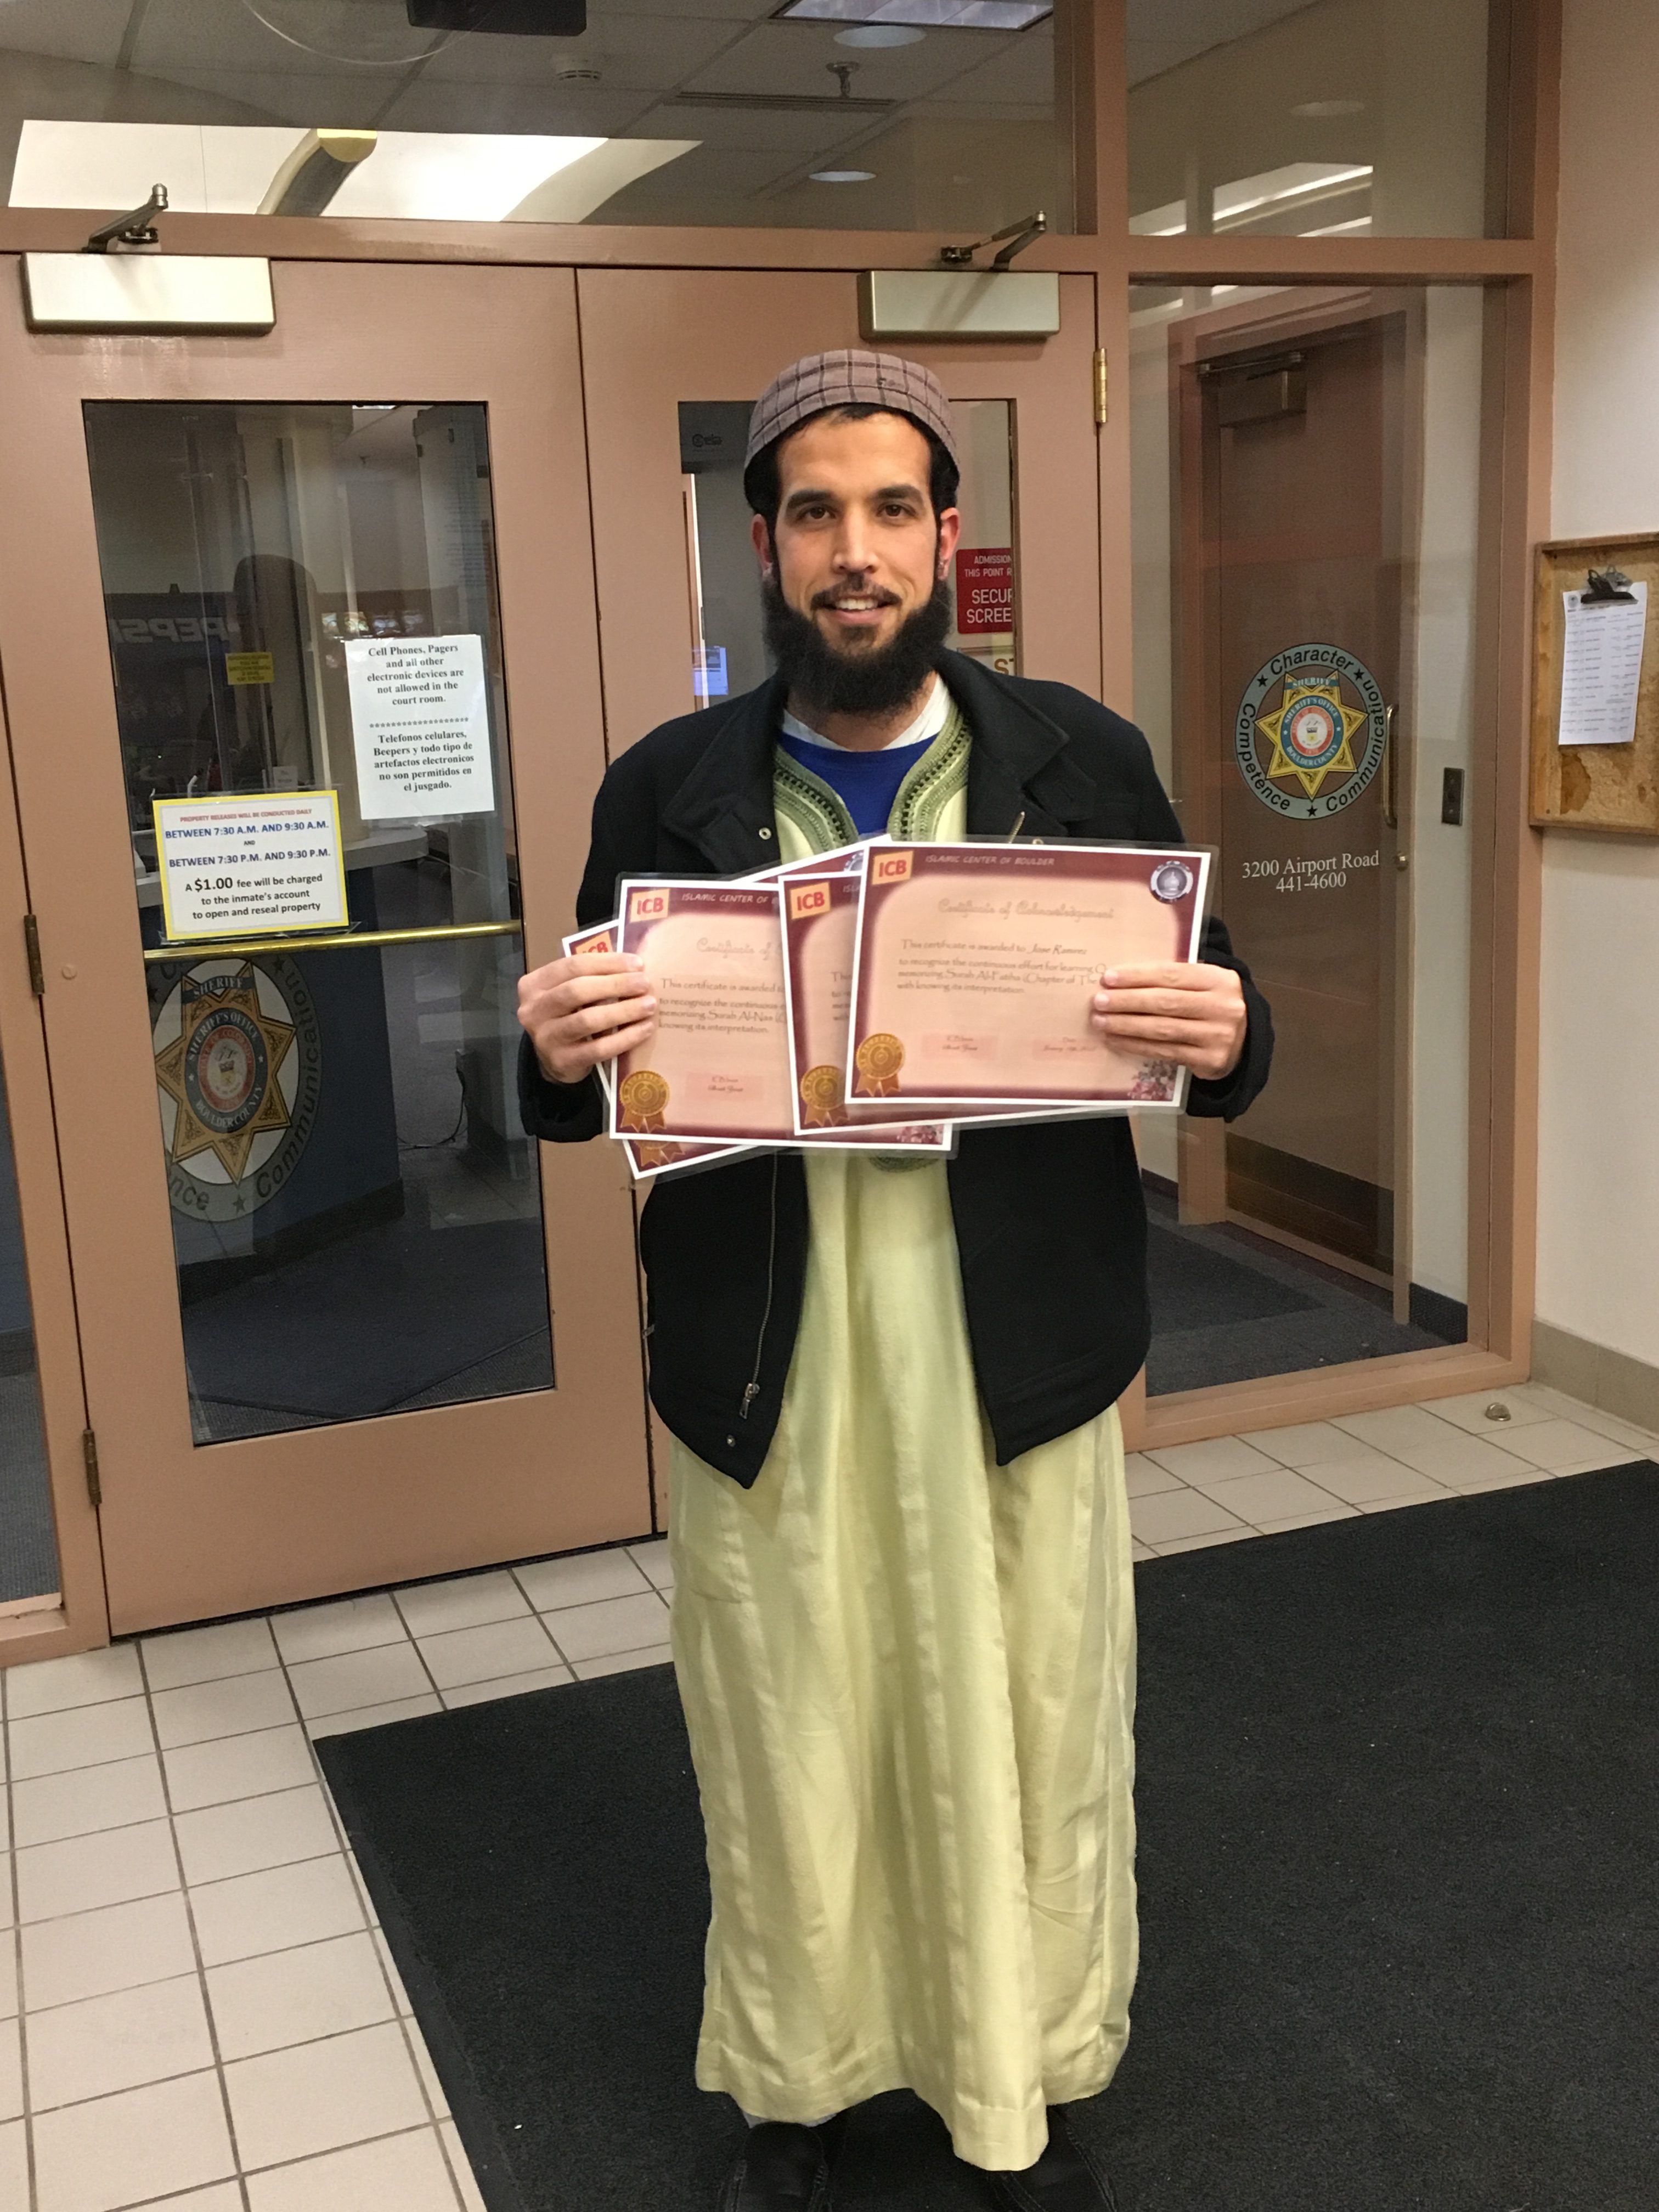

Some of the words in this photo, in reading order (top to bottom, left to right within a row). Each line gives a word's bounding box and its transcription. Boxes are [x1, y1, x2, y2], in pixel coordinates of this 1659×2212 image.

[965, 569, 980, 577] THIS
[983, 568, 1003, 577] POINT
[368, 646, 387, 657] Cell
[391, 646, 426, 656] Phones,
[428, 645, 458, 654] Pagers
[386, 659, 403, 668] and
[406, 658, 417, 667] all
[420, 658, 444, 666] other
[1271, 649, 1354, 675] Character
[368, 672, 413, 681] electronic
[415, 670, 448, 679] devices
[396, 682, 430, 693] allowed
[392, 697, 416, 705] court
[378, 733, 422, 743] Telefonos
[425, 731, 466, 741] celulares,
[374, 747, 410, 757] Beepers
[421, 744, 441, 753] todo
[443, 743, 461, 754] tipo
[1326, 680, 1384, 811] Communication
[374, 759, 420, 768] artefactos
[422, 755, 474, 765] electronicos
[1239, 703, 1290, 810] Competence
[412, 768, 460, 781] permitidos
[414, 781, 452, 792] jusgado.
[166, 829, 211, 839] BETWEEN
[214, 827, 234, 836] 7:30
[237, 826, 258, 834] A.M.
[262, 824, 282, 832] AND
[285, 822, 304, 831] 9:30
[307, 821, 329, 829] A.M.
[169, 857, 215, 868] BETWEEN
[218, 855, 238, 864] 7:30
[241, 854, 262, 862] P.M.
[264, 852, 285, 860] AND
[287, 850, 307, 859] 9:30
[926, 855, 960, 863] ISLAMIC
[963, 855, 996, 864] CENTER
[1015, 857, 1054, 865] BOULDER
[1242, 860, 1279, 878] 3200
[1283, 856, 1337, 876] Airport
[1342, 850, 1379, 869] Road
[878, 860, 907, 878] ICB
[194, 877, 233, 892] $1.00
[237, 879, 251, 888] fee
[254, 878, 270, 887] will
[273, 877, 284, 885] be
[286, 874, 323, 885] charged
[1276, 872, 1346, 893] 441-4600
[213, 895, 229, 904] the
[274, 890, 309, 900] account
[797, 891, 825, 911] ICB
[205, 910, 229, 919] open
[232, 907, 249, 916] and
[251, 905, 279, 915] reseal
[281, 902, 321, 913] property
[637, 898, 664, 915] ICB
[901, 939, 921, 949] This
[194, 977, 242, 996] SHERIFF
[661, 978, 681, 989] This
[684, 980, 727, 990] certificate
[739, 983, 775, 992] awarded
[714, 998, 727, 1007] the
[707, 1009, 736, 1020] Surah
[256, 971, 319, 1198] Communication
